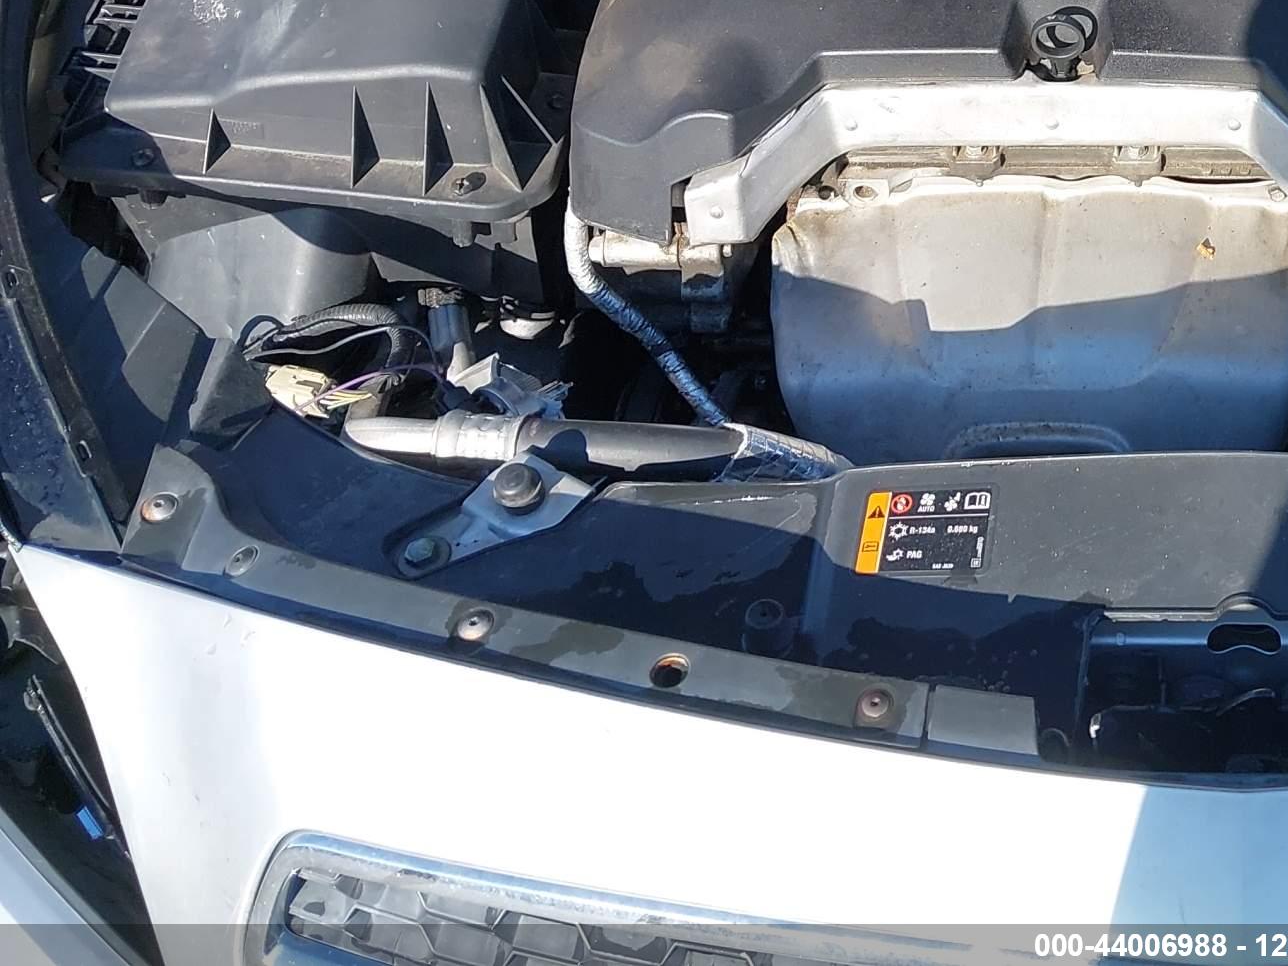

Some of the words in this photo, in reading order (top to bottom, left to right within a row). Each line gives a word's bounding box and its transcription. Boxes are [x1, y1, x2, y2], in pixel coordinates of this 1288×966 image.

[917, 505, 936, 513] AUTO
[909, 526, 936, 534] R-134a
[969, 524, 979, 534] kg
[906, 550, 923, 559] PAG
